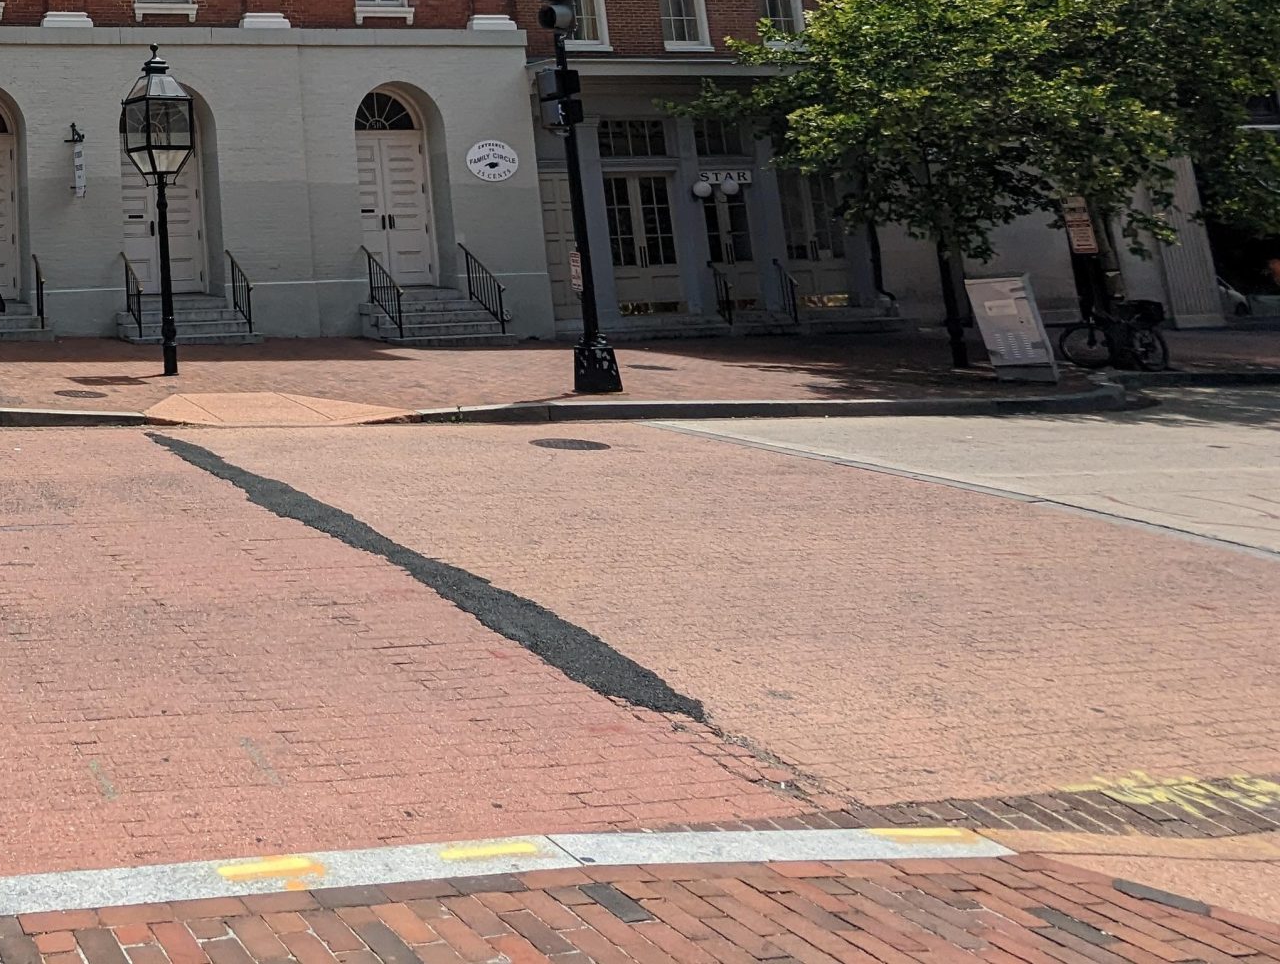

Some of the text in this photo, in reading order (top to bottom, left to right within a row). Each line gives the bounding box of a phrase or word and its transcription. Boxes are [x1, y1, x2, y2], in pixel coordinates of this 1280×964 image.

[478, 142, 505, 150] ENTRANCE
[469, 152, 516, 165] FAMILY CIRCLE
[477, 168, 511, 179] 25 CENTS
[700, 171, 748, 182] STAR
